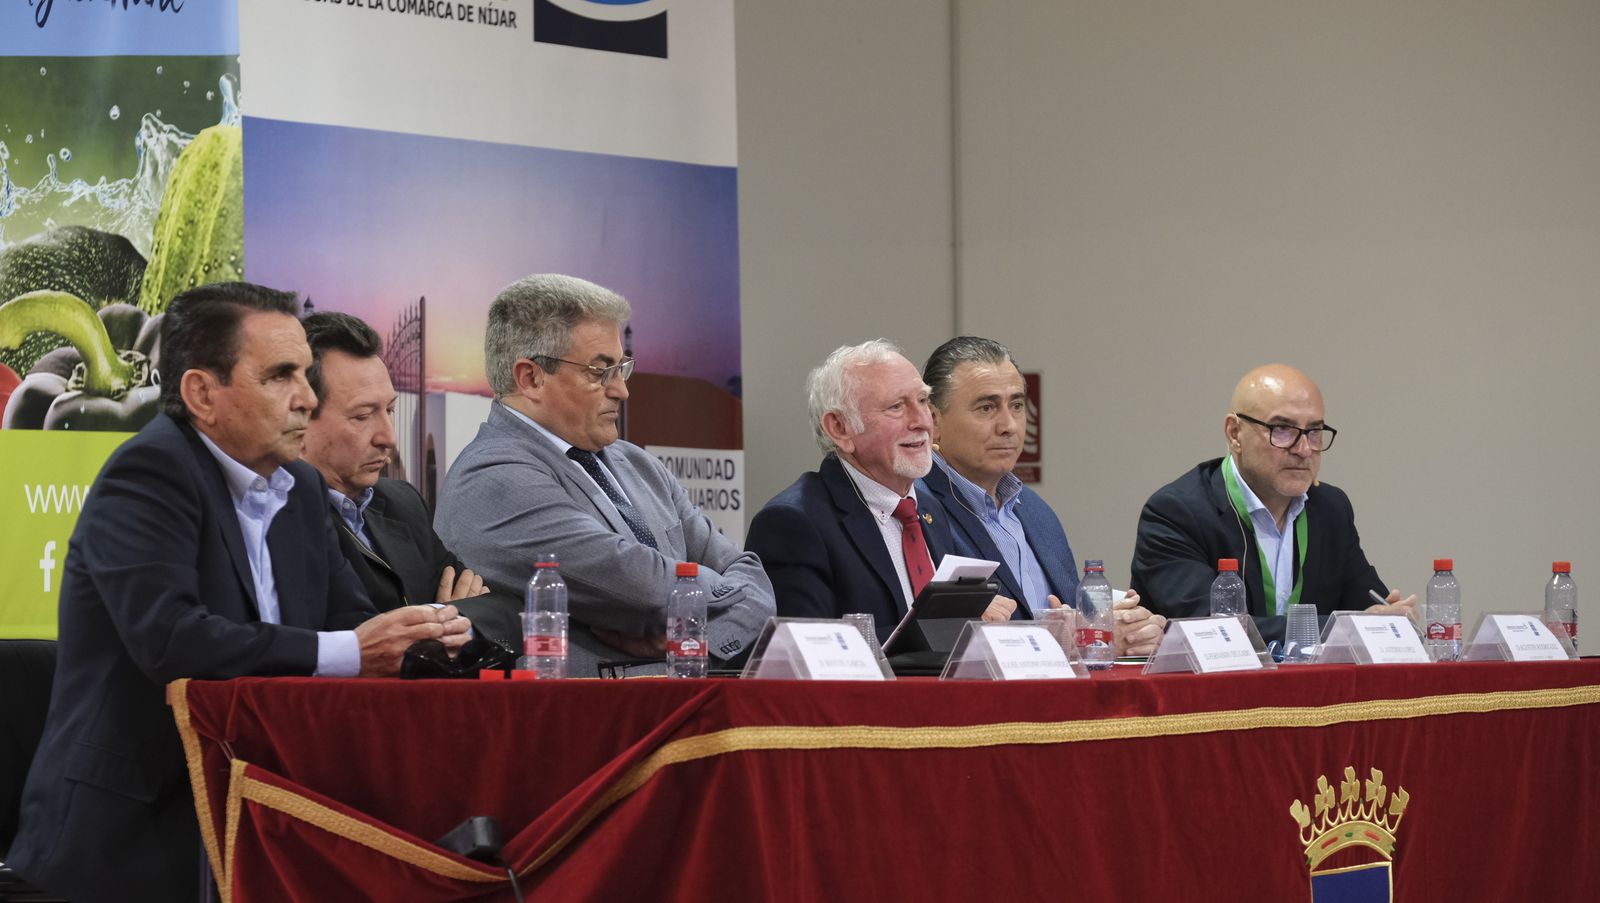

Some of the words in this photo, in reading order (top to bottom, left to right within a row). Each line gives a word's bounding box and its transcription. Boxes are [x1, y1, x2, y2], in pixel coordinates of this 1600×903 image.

[386, 0, 454, 20] COMARCA
[457, 3, 474, 22] DE
[478, 2, 517, 28] NÍJAR
[657, 456, 735, 480] OMUNIDAD
[687, 487, 740, 511] UARIOS
